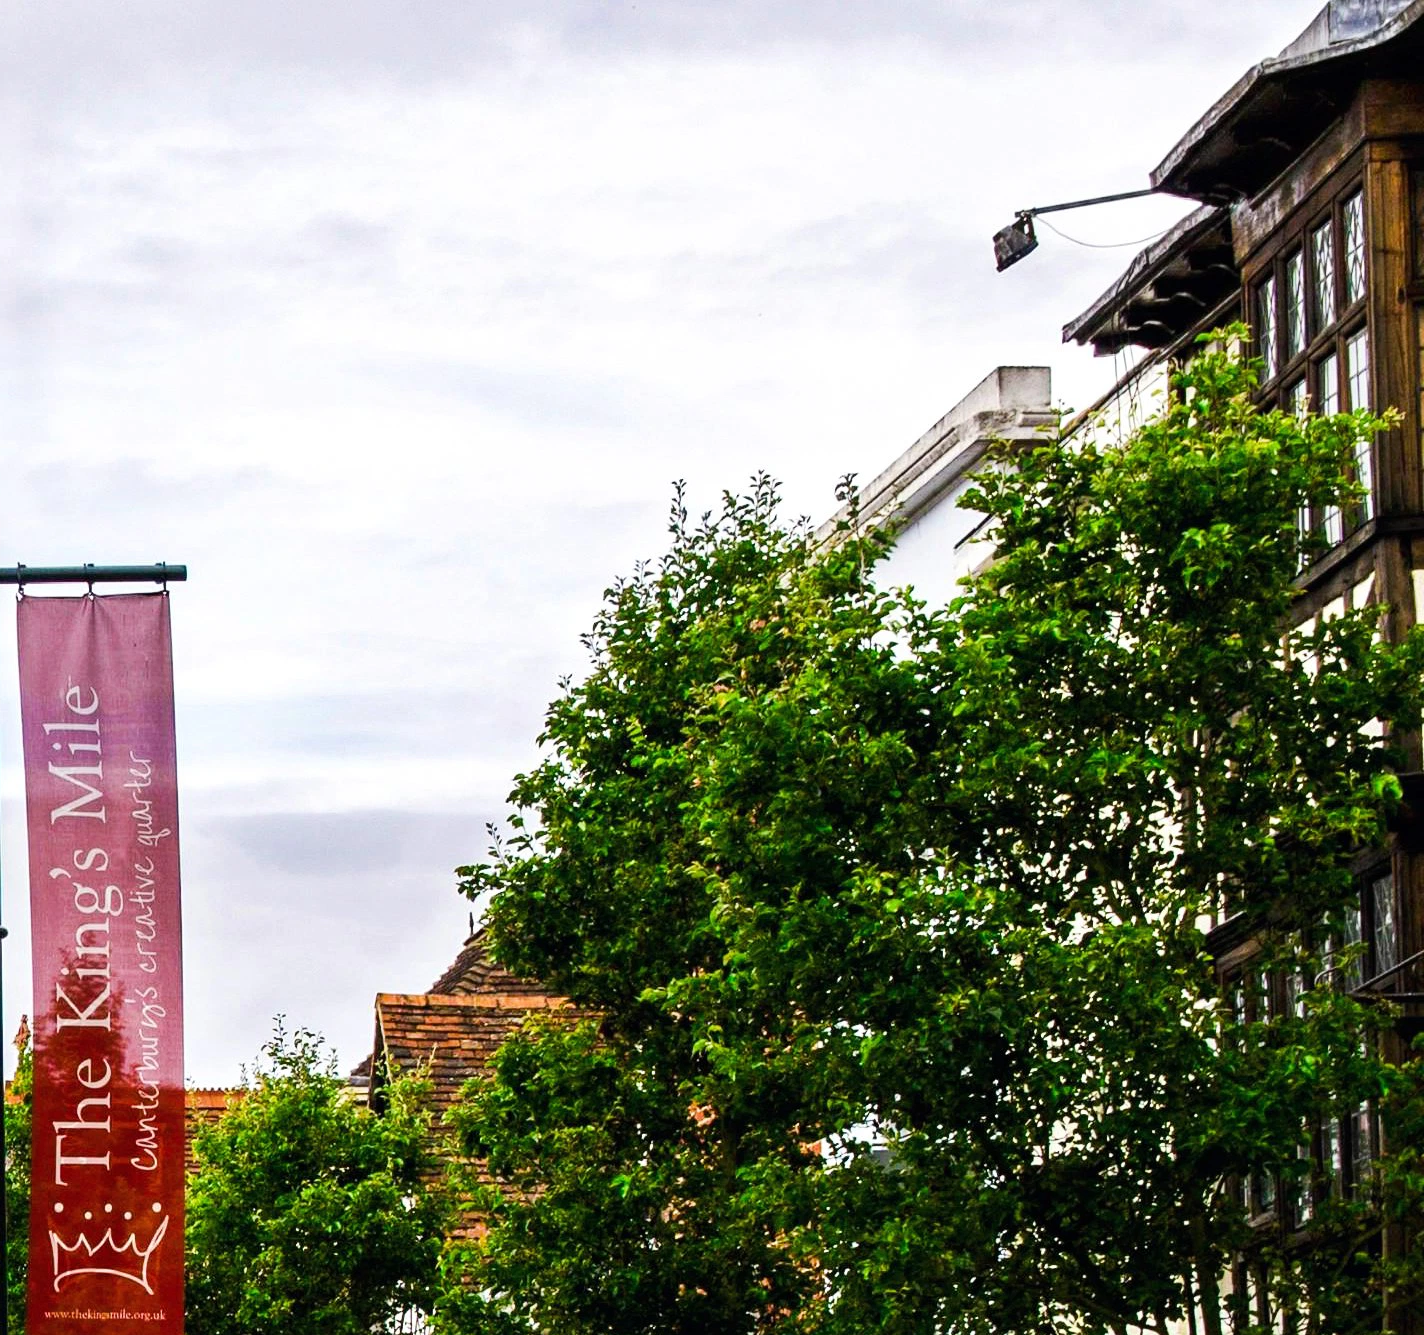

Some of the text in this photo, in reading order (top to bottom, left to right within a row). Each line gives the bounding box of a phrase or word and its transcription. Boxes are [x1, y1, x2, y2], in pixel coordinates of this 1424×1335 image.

[123, 750, 172, 848] quarter
[42, 684, 124, 1187] The King's Mile
[128, 856, 157, 973] creative
